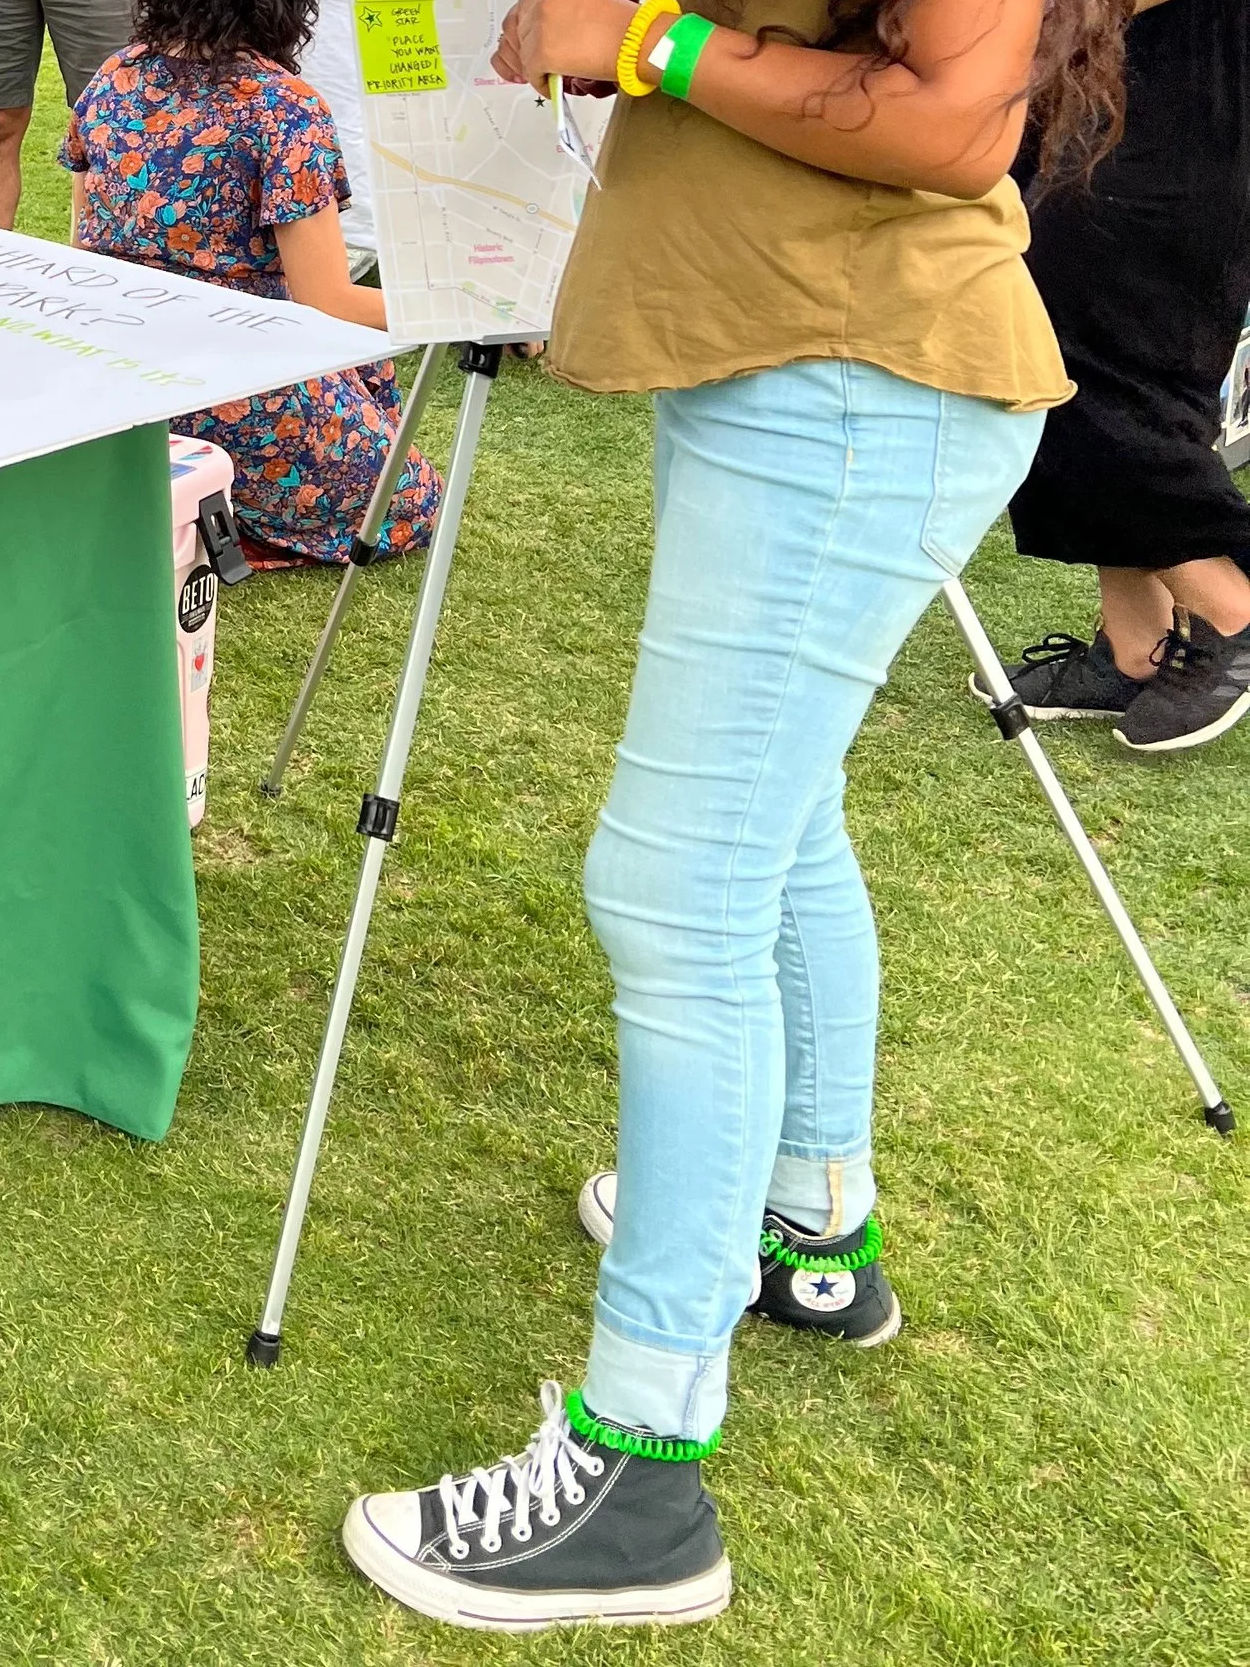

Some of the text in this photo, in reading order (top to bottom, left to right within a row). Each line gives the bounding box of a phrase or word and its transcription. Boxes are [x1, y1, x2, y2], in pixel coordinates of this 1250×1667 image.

[395, 17, 420, 27] STAR
[392, 34, 425, 46] PLACE
[391, 45, 440, 58] YOU WANT
[367, 74, 444, 91] PRIORITY AREA
[474, 243, 503, 252] Historic
[122, 287, 200, 309] OF
[207, 306, 303, 334] THE
[31, 329, 117, 358] WHAT
[106, 357, 143, 370] IS
[182, 572, 214, 615] BETO
